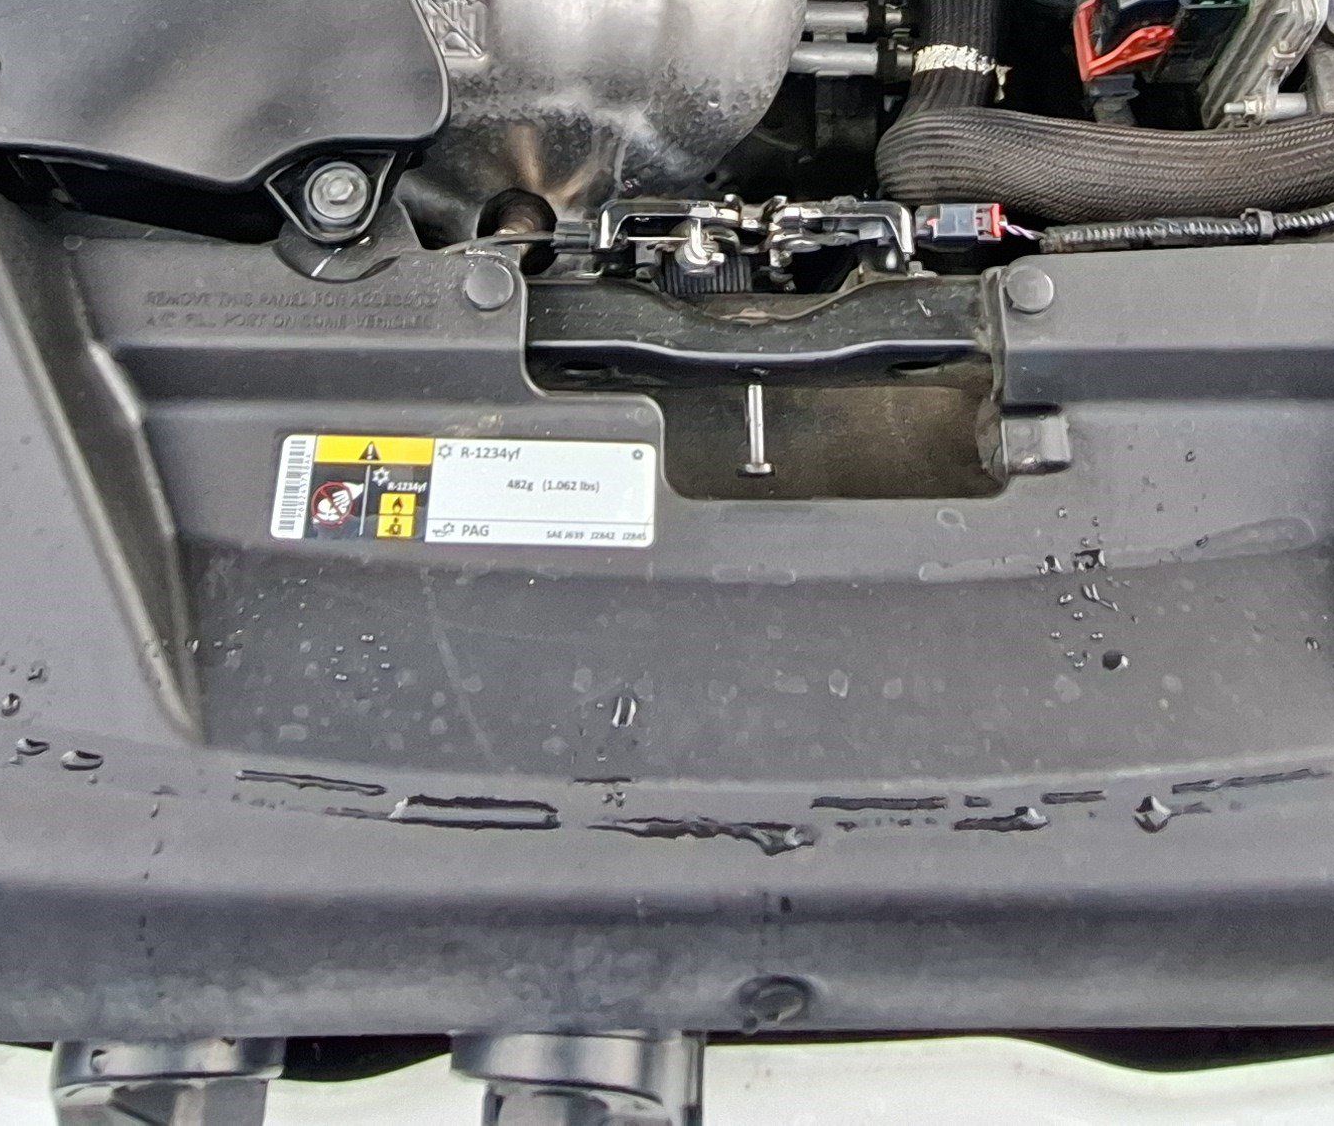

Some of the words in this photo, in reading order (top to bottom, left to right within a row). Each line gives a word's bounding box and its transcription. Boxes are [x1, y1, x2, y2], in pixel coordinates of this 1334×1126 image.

[460, 446, 522, 463] R-1234yf
[506, 478, 534, 492] 482g
[542, 478, 577, 493] (1.062
[579, 478, 601, 493] lbs)
[461, 523, 490, 538] PAG
